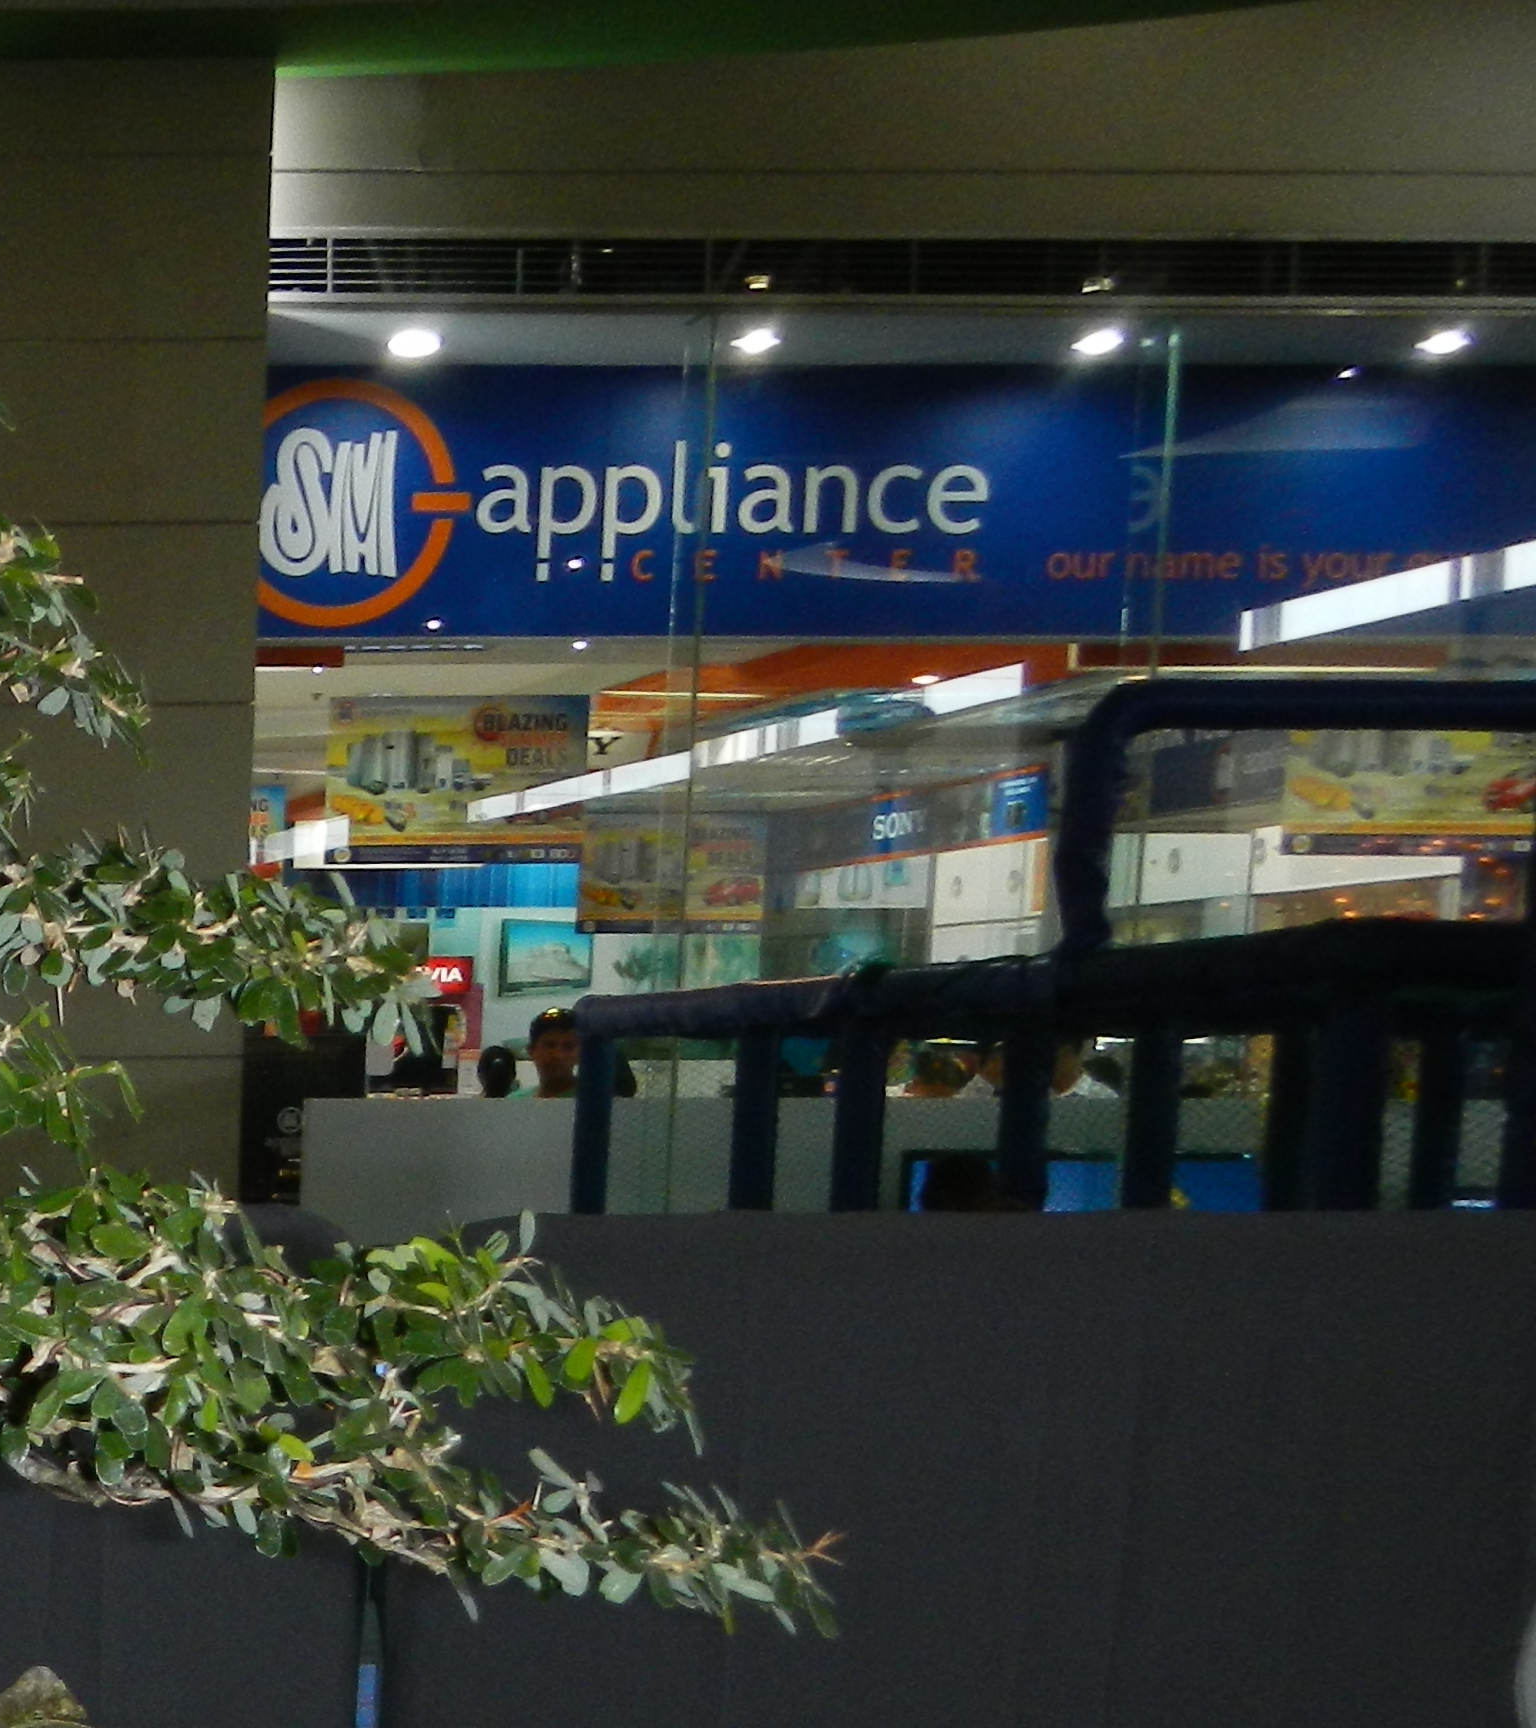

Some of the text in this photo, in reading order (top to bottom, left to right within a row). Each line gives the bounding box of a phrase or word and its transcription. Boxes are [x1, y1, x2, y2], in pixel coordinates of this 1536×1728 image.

[259, 427, 990, 583] SM appliance
[630, 549, 981, 582] CENTER
[1046, 551, 1115, 581] our
[1125, 550, 1243, 581] name
[1257, 544, 1289, 581] is
[1301, 551, 1394, 589] your
[484, 713, 568, 732] BLAZING
